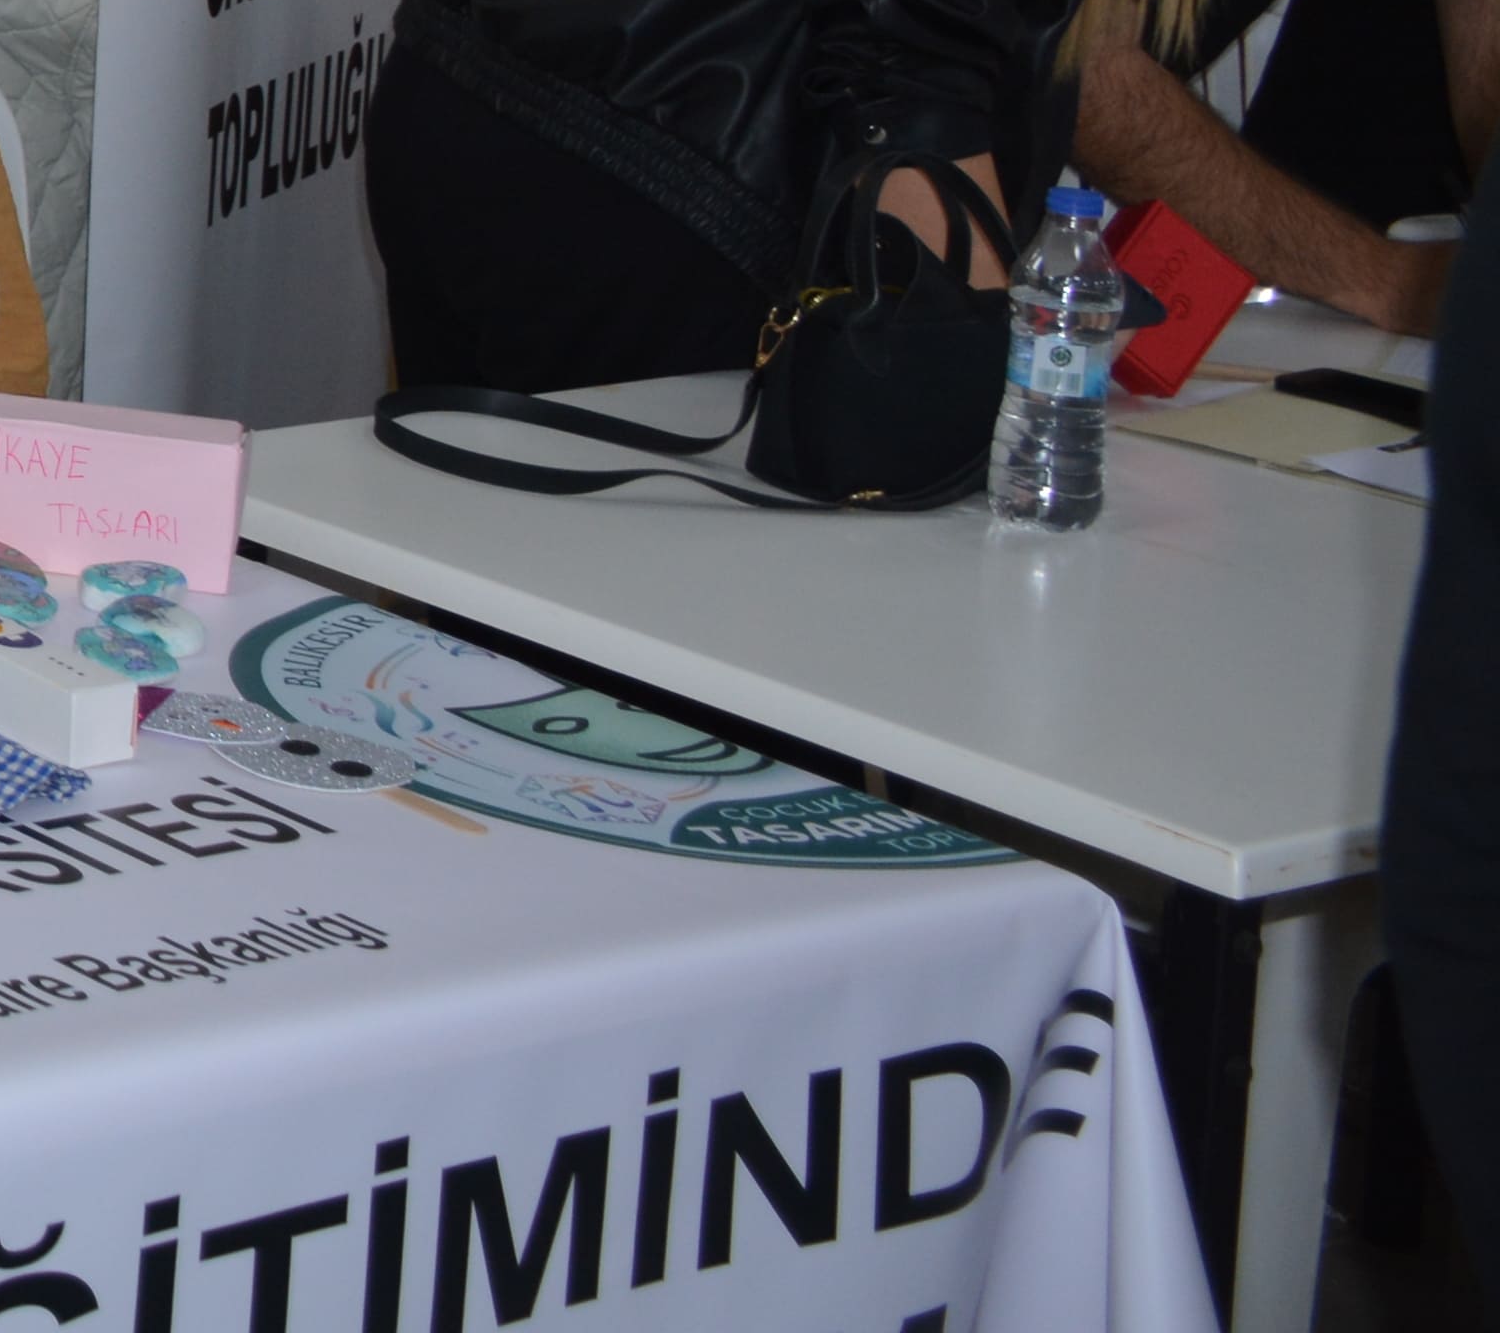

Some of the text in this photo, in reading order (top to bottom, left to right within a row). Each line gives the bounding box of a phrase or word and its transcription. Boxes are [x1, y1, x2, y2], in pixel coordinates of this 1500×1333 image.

[46, 501, 180, 545] TAŞLARI
[283, 614, 385, 690] BALIKESİR
[718, 793, 849, 823] ÇOCUK
[53, 906, 389, 993] Başkanlığı
